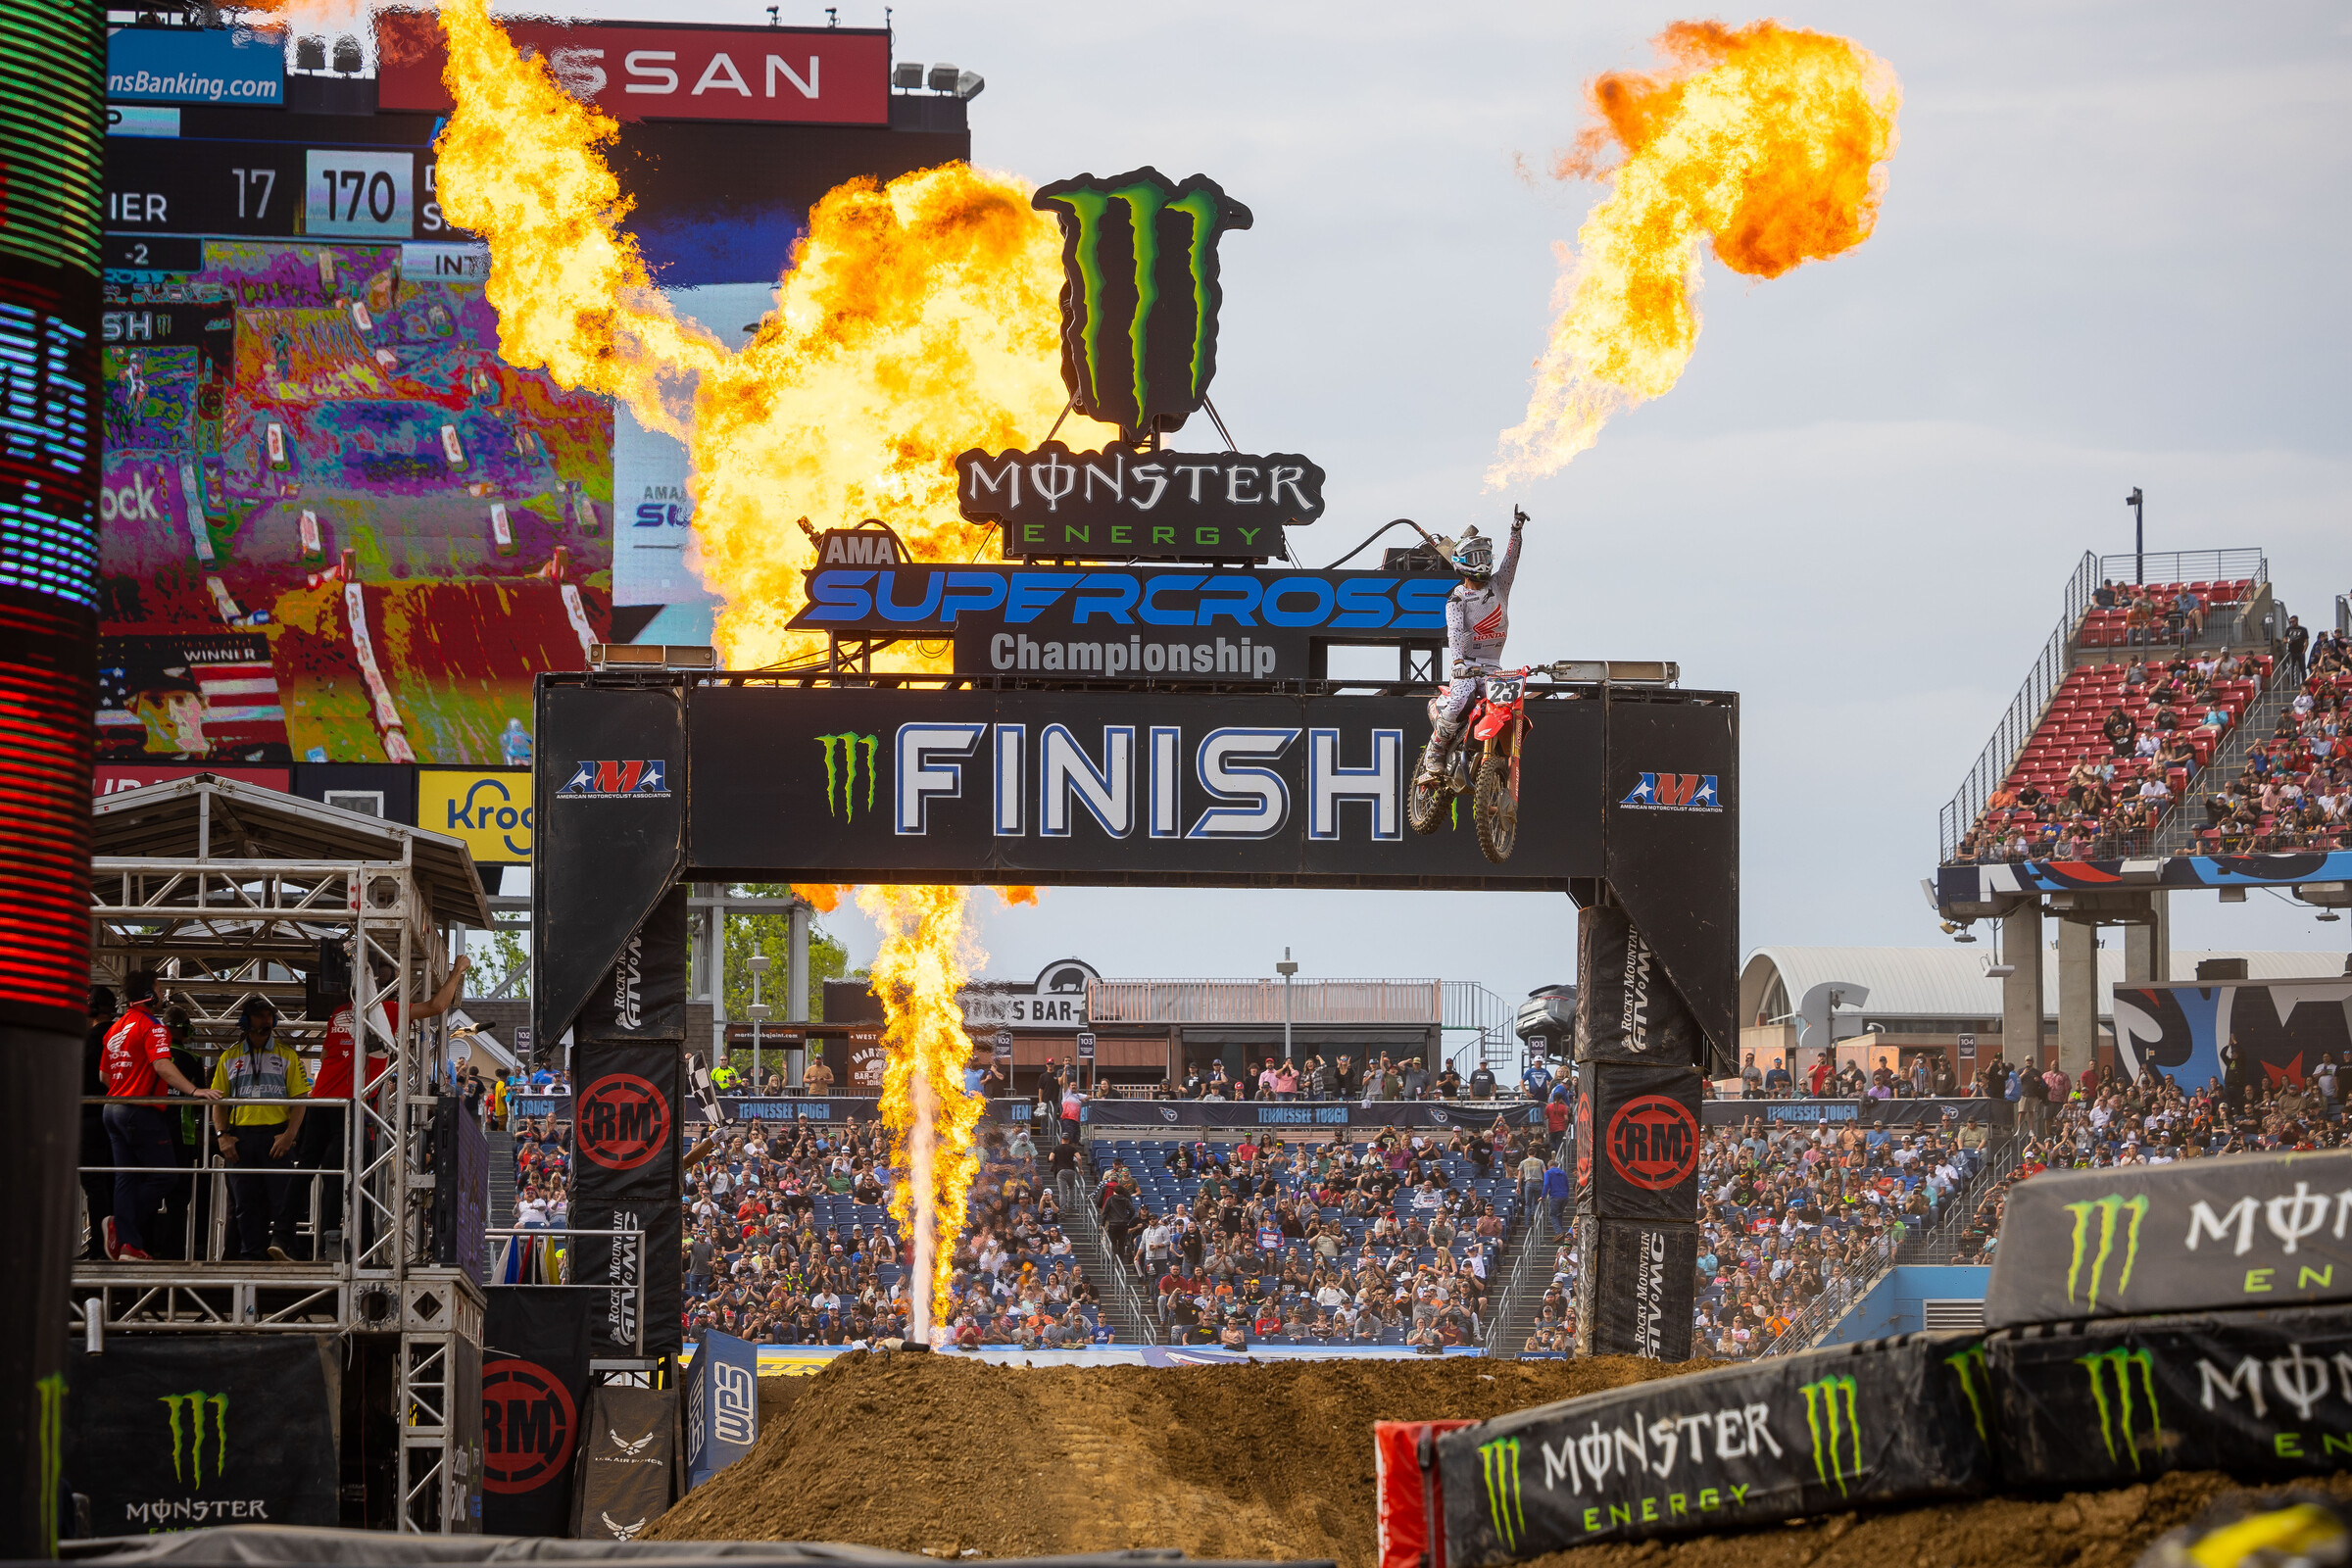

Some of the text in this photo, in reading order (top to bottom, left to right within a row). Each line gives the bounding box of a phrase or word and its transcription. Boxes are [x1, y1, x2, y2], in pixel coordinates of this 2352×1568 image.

[111, 192, 168, 222] IER
[232, 168, 275, 219] 17
[322, 170, 396, 222] 170
[966, 454, 1316, 511] MONSTER
[825, 529, 895, 565] AMA
[1024, 524, 1262, 547] ENERGY
[804, 569, 1463, 628] SUPERCROSS
[991, 633, 1276, 680] Championship
[1473, 632, 1506, 642] HONDA
[1490, 682, 1520, 703] 23
[556, 760, 672, 794] AMA
[894, 721, 1403, 842] FINISH
[1619, 771, 1724, 808] AMA
[1621, 989, 1635, 1032] ROCKY
[521, 1100, 556, 1116] TOUGH
[593, 1102, 651, 1142] RM
[739, 1103, 830, 1119] TENNESSEE TOUGH
[1257, 1107, 1348, 1123] TENNESSEE TOUGH
[1767, 1105, 1858, 1121] TENNESSEE TOUGH
[1625, 1122, 1683, 1162] RM
[608, 1210, 623, 1325] ROCKY MOUNTAIN
[1635, 1231, 1650, 1346] ROCKY MOUNTAIN
[1541, 1402, 1784, 1495] MONSTER
[126, 1497, 270, 1524] MONSTER
[1583, 1483, 1751, 1533] ENERGY
